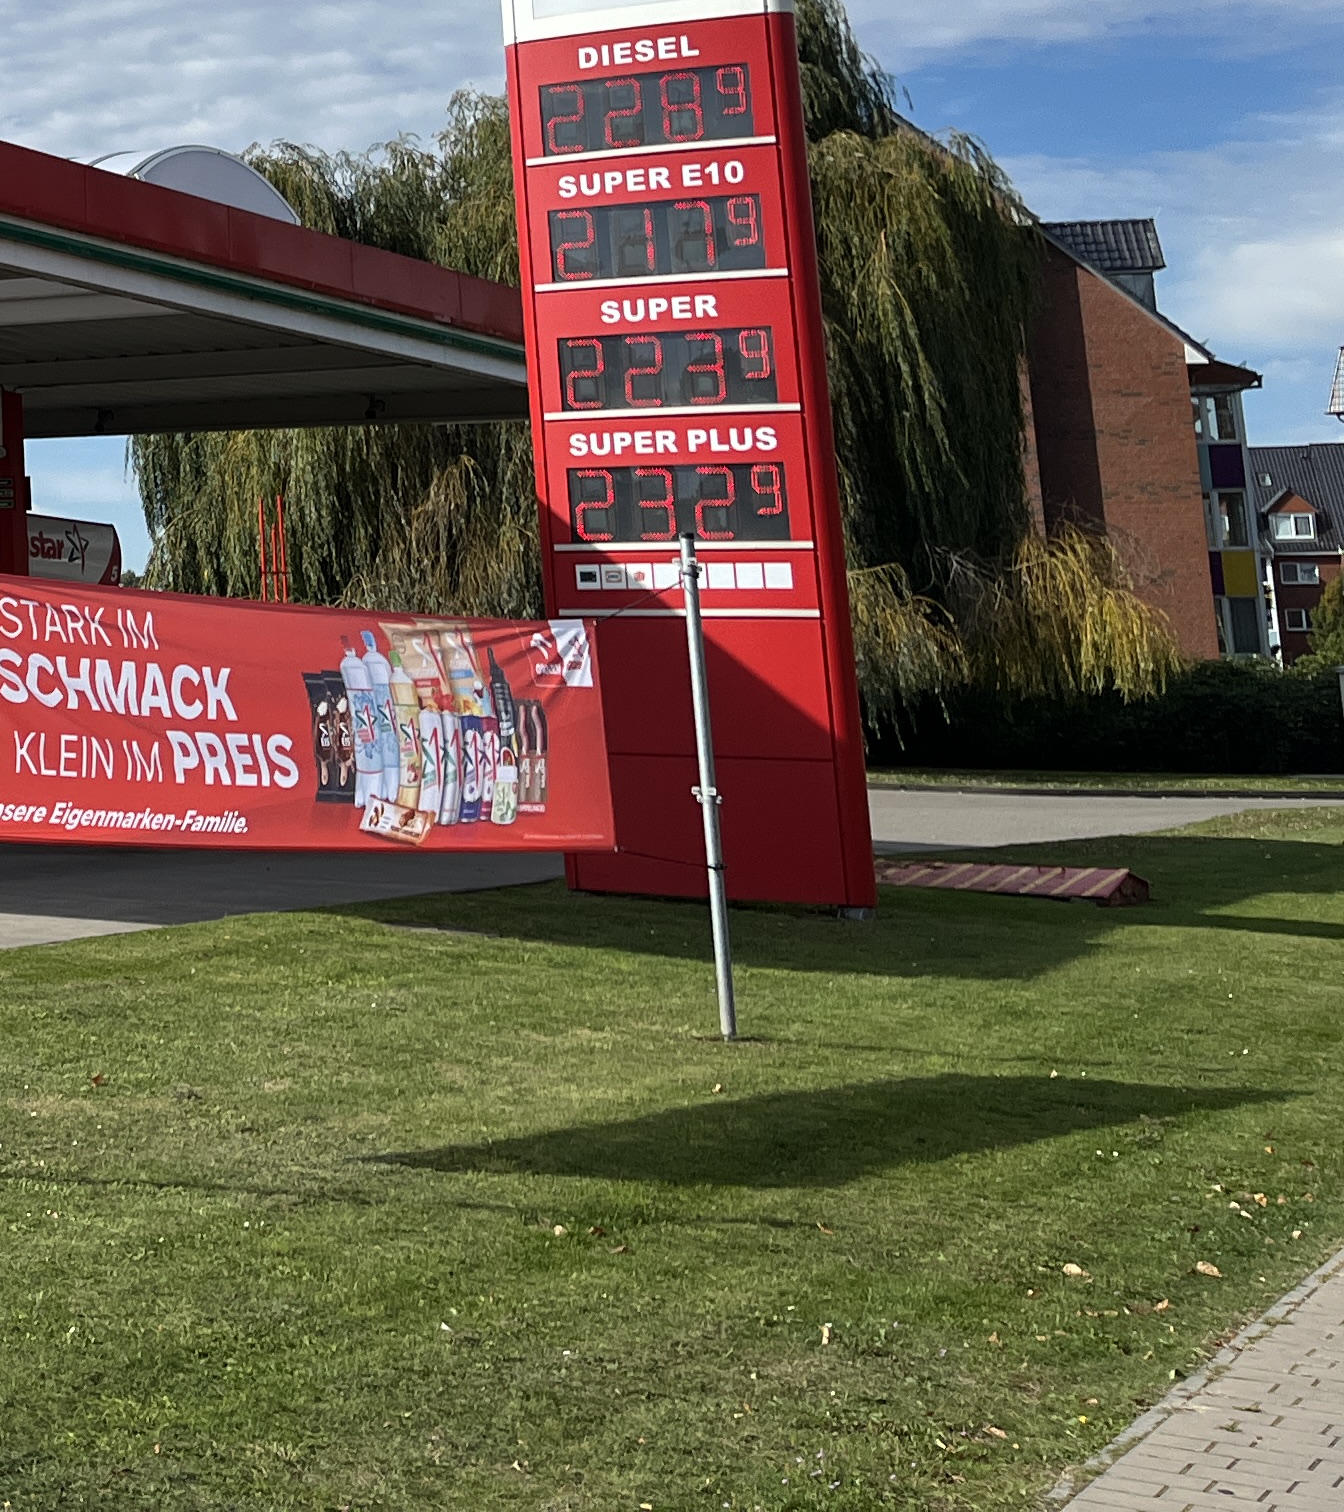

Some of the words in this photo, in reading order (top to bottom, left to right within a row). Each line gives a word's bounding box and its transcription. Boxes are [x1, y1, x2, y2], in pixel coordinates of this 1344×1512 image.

[578, 35, 700, 69] DIESEL
[558, 167, 671, 199] SUPER
[682, 160, 744, 187] E10
[600, 295, 718, 324] SUPER
[568, 429, 678, 457] SUPER
[687, 426, 778, 452] PLUS
[30, 531, 64, 560] star
[117, 607, 159, 650] IM
[13, 730, 114, 780] KLEIN
[122, 740, 162, 783] IM
[165, 730, 299, 788] PREIS
[49, 801, 249, 834] Eigenmarken-Familie.
